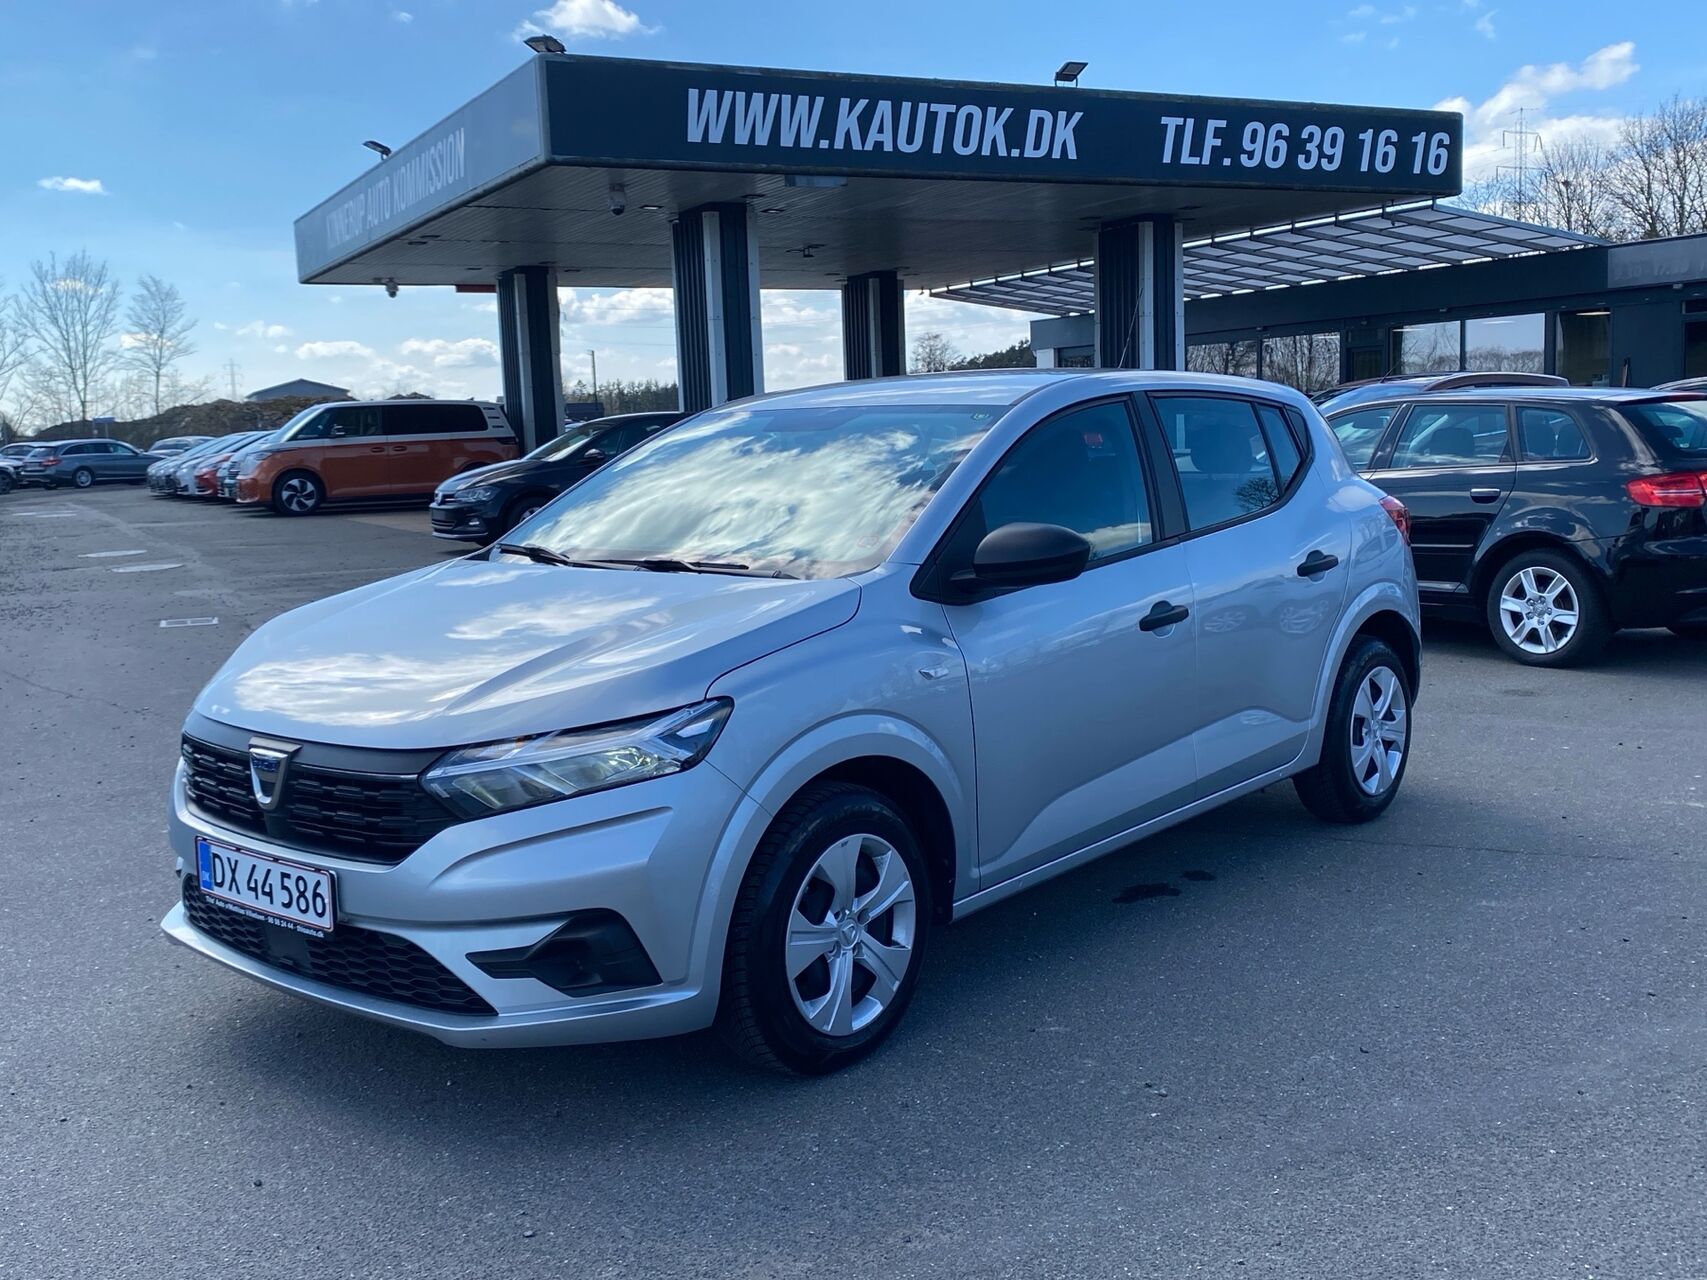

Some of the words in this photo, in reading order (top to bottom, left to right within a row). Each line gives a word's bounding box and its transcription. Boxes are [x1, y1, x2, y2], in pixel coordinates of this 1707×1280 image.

[687, 88, 1084, 160] WWW.KAUTOK.DK
[1161, 116, 1232, 166] TLF.
[1240, 121, 1290, 169] 96
[1298, 125, 1345, 171] 39
[1358, 128, 1399, 173] 16
[1412, 131, 1451, 175] 16
[366, 176, 391, 230] AUTO
[393, 127, 465, 215] KOMMISSION
[212, 852, 241, 894] DX
[247, 864, 274, 905] 44
[280, 871, 327, 918] 586
